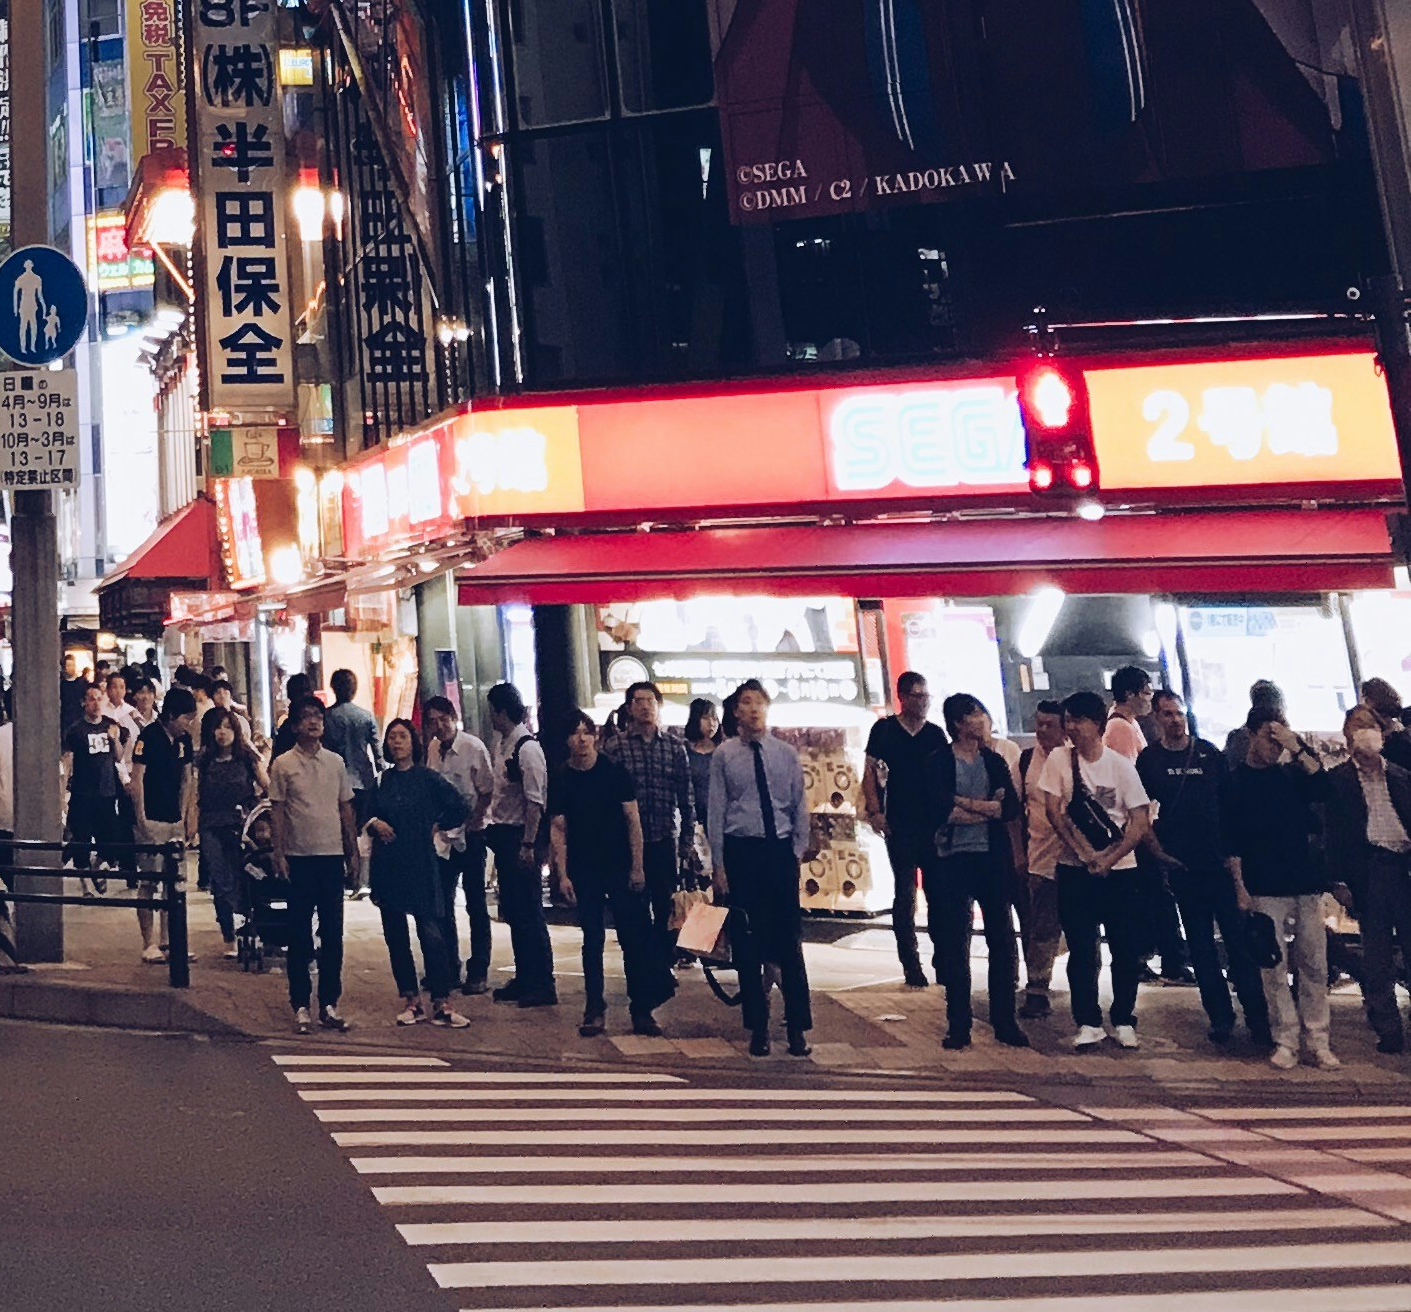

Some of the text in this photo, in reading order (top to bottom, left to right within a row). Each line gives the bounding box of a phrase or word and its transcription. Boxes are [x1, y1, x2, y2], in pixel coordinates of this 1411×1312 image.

[143, 1, 169, 45] 免税
[145, 53, 174, 113] TAX
[829, 179, 852, 200] C2
[833, 387, 1029, 489] SEG
